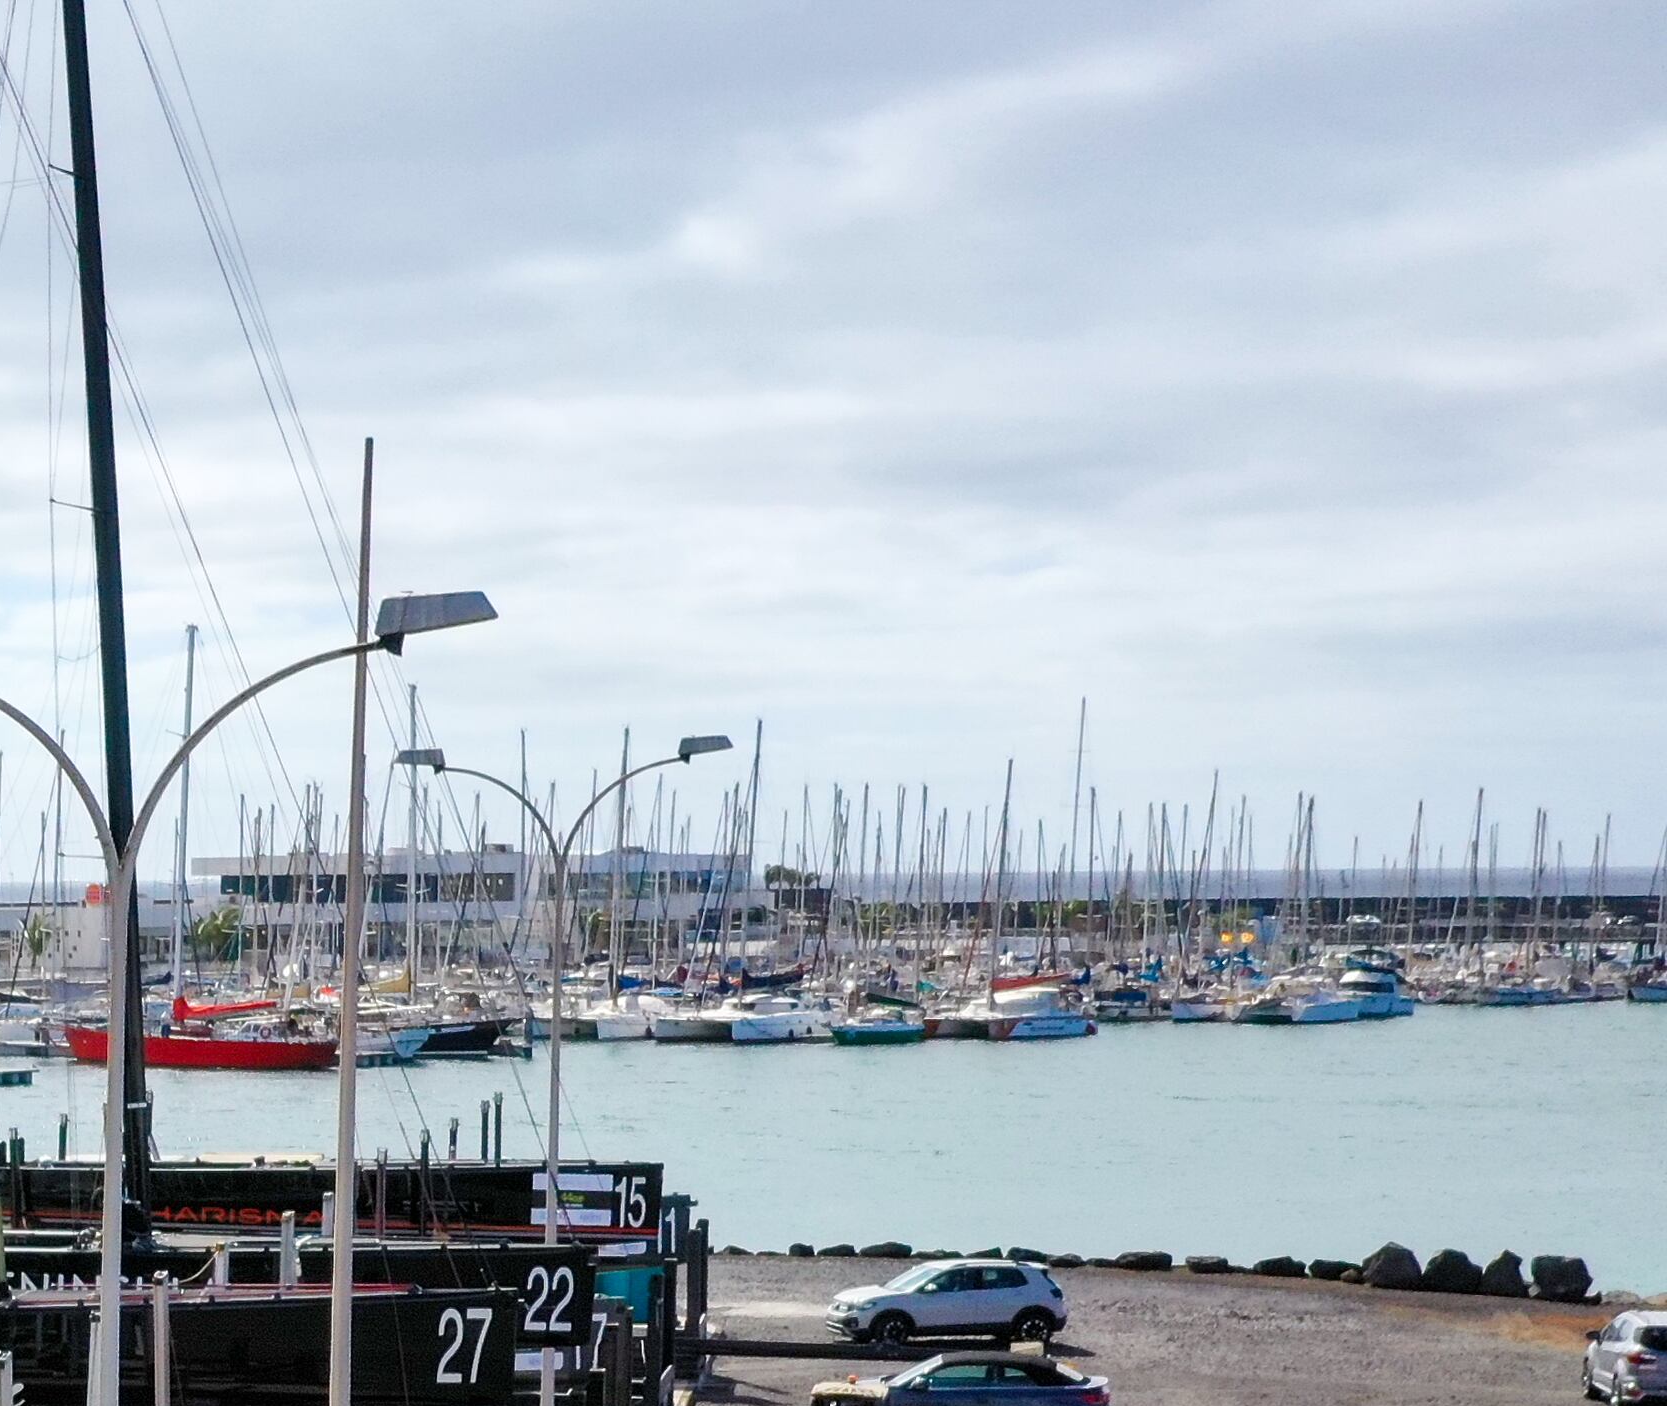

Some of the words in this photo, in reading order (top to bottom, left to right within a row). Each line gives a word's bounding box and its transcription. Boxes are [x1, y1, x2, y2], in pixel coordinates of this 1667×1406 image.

[615, 1176, 647, 1228] 15
[524, 1266, 573, 1332] 22
[437, 1308, 493, 1385] 27
